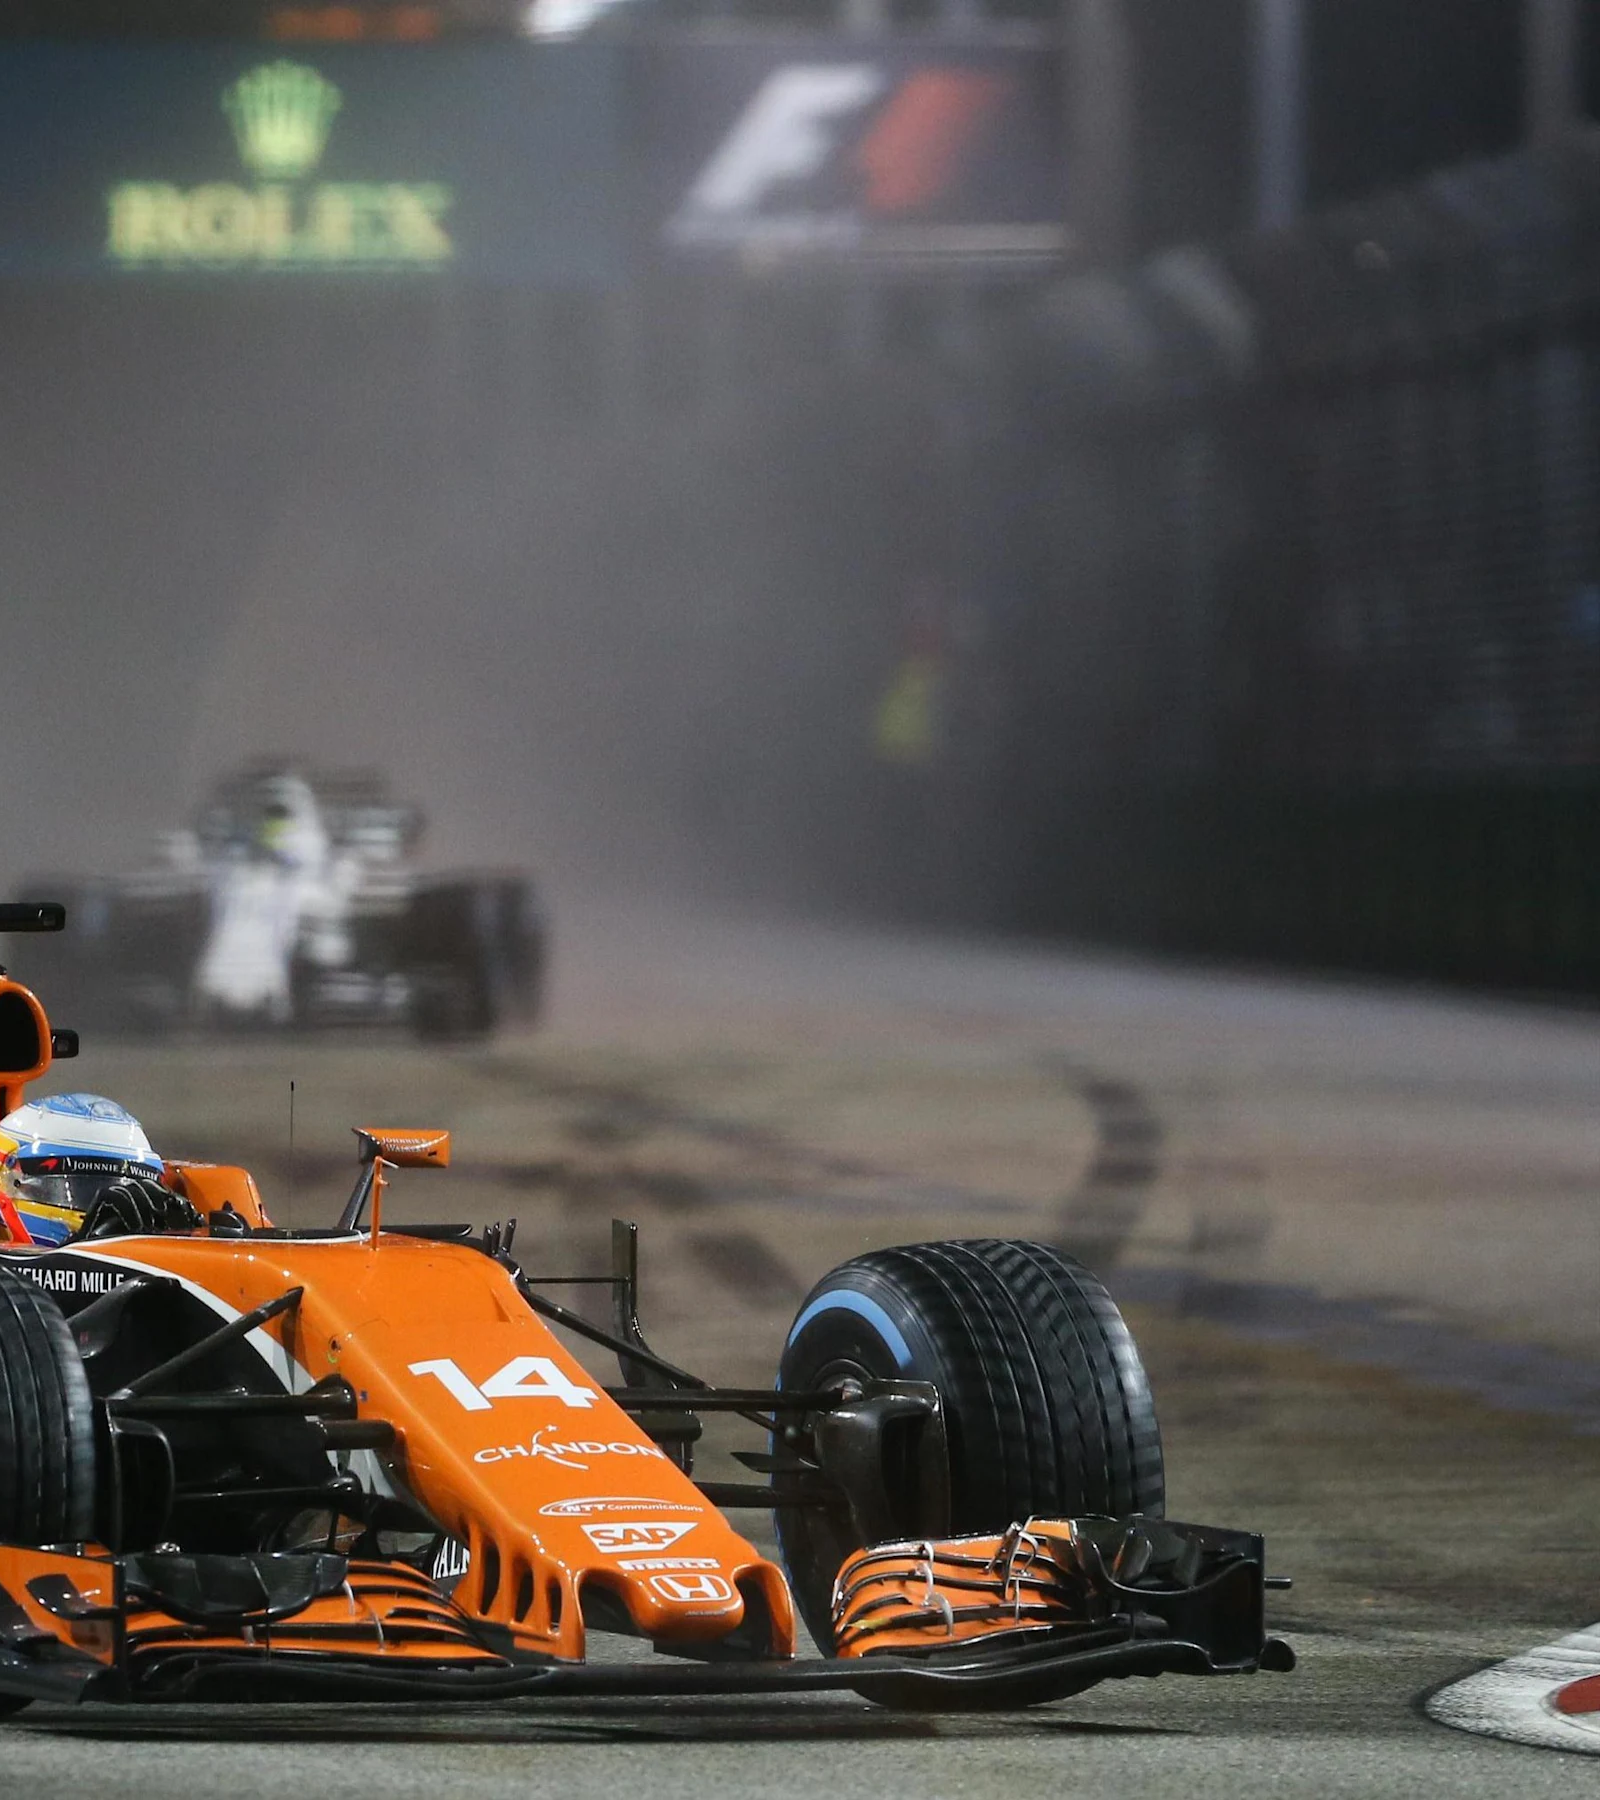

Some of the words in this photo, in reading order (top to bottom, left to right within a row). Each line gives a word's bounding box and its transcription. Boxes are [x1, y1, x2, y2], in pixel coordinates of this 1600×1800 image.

[108, 180, 452, 270] ROLEX
[72, 1160, 119, 1173] JOHNNIE
[12, 1267, 77, 1292] HARD
[407, 1356, 599, 1411] 14
[473, 1441, 665, 1464] CHANDON
[565, 1503, 606, 1513] NTT
[606, 1503, 704, 1513] Communications
[590, 1527, 676, 1547] SAP
